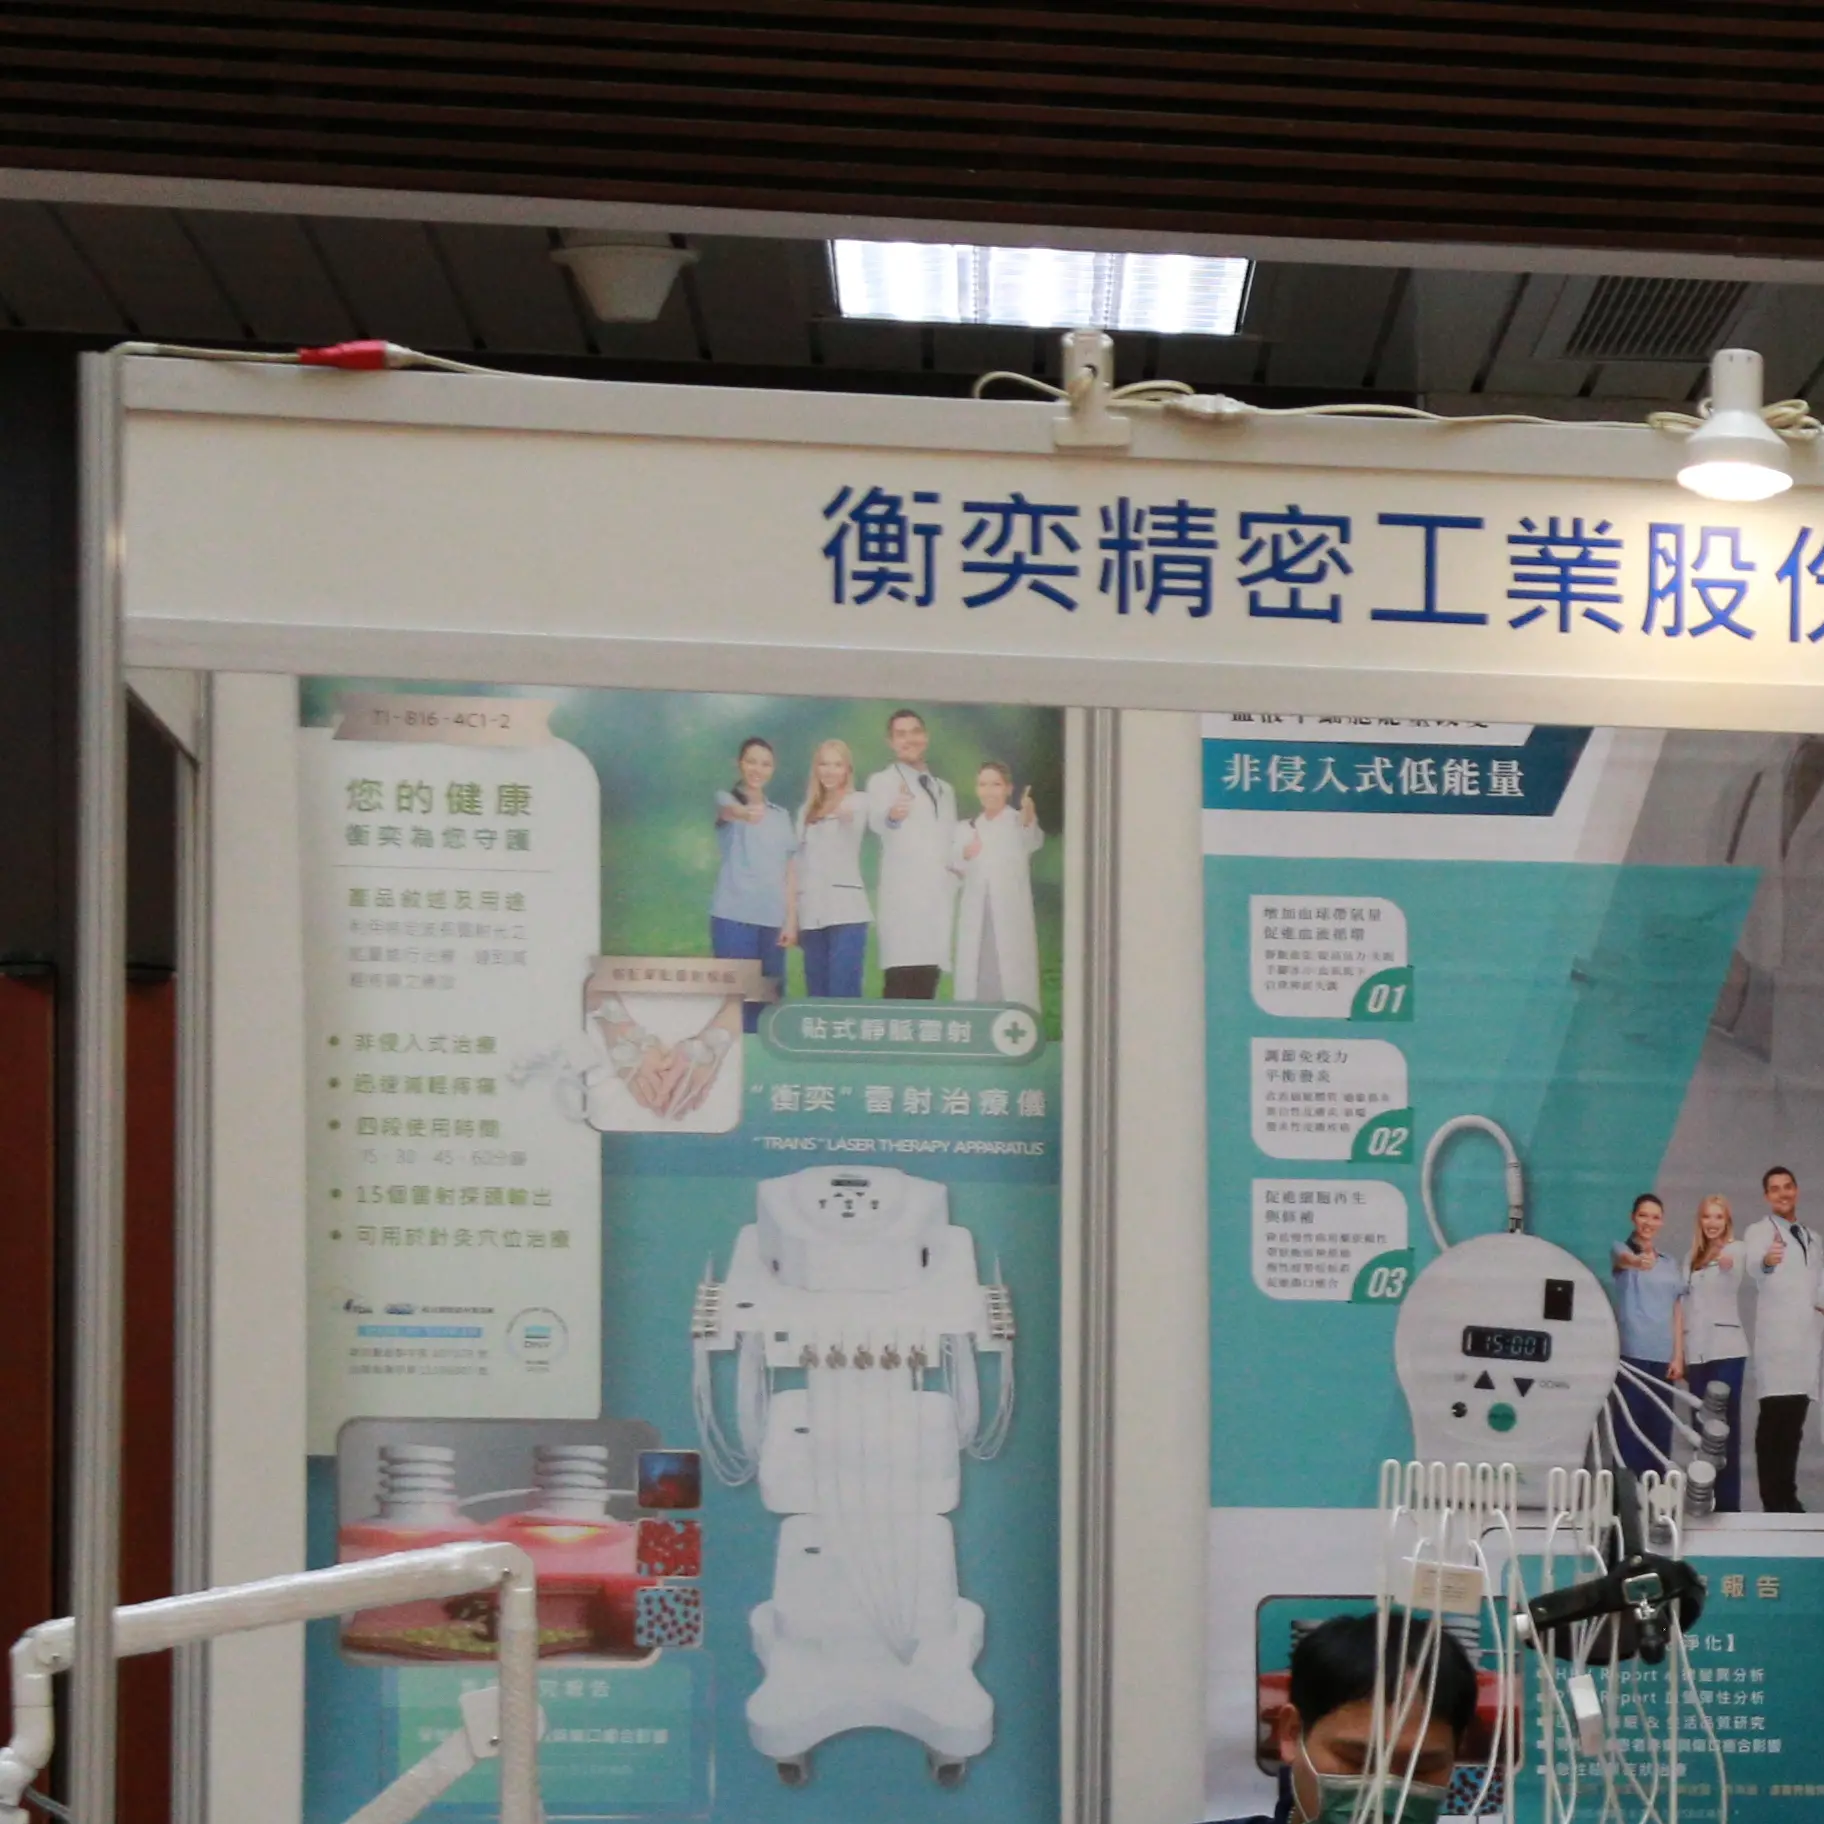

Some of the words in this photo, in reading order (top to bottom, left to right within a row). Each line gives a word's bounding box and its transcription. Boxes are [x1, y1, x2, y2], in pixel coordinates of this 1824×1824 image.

[1221, 753, 1526, 798] 非侵入式低能量
[345, 777, 532, 817] 您的健康
[345, 823, 531, 852] 衡奕為您守護
[1366, 984, 1407, 1013] 01
[801, 1016, 972, 1043] 貼式靜脈雷射
[827, 1137, 876, 1152] LASER
[881, 1139, 949, 1153] THERAPY
[1367, 1128, 1408, 1157] 02
[1367, 1268, 1408, 1298] 03
